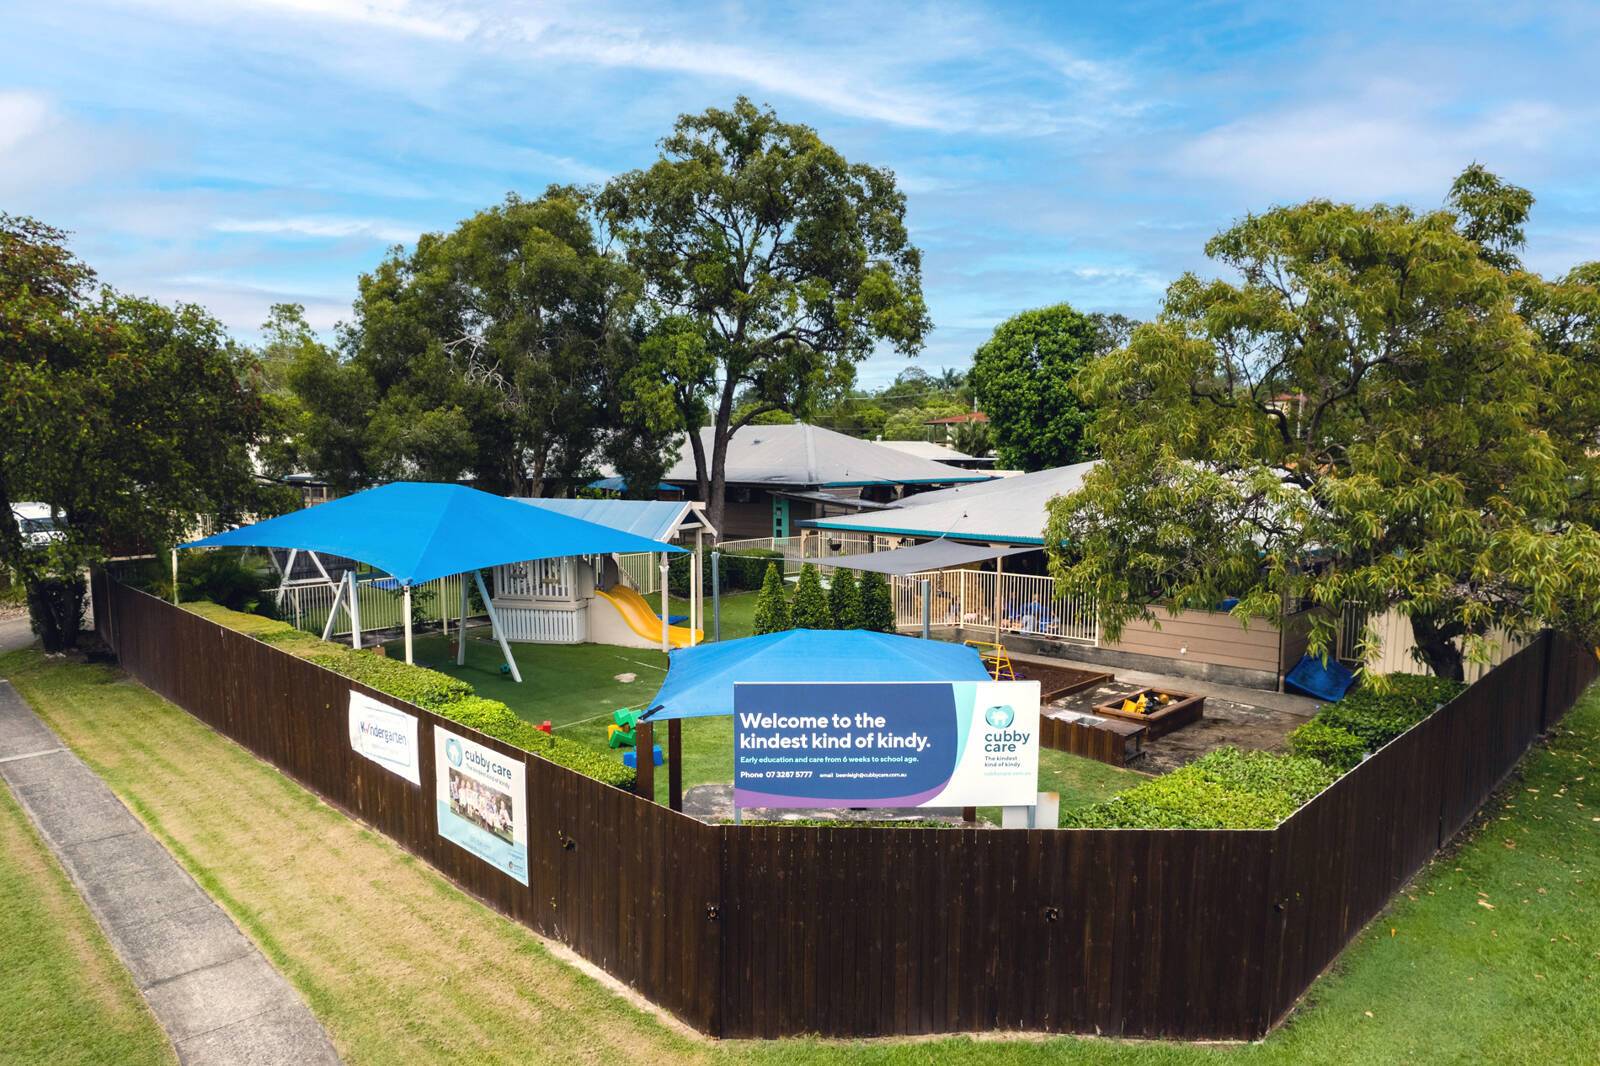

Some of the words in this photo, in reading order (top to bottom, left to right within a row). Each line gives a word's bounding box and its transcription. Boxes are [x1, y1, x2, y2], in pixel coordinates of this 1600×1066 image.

[740, 712, 829, 729] Welcome
[832, 713, 852, 729] to
[855, 712, 886, 729] the
[360, 720, 407, 746] Kindergarten
[740, 732, 808, 749] kindest
[811, 732, 852, 749] kind
[855, 732, 874, 749] of
[877, 731, 931, 752] kindy.
[984, 730, 1030, 745] cubby
[984, 743, 1016, 752] care
[465, 750, 491, 772] cubby
[491, 763, 512, 779] care
[740, 756, 758, 765] Early
